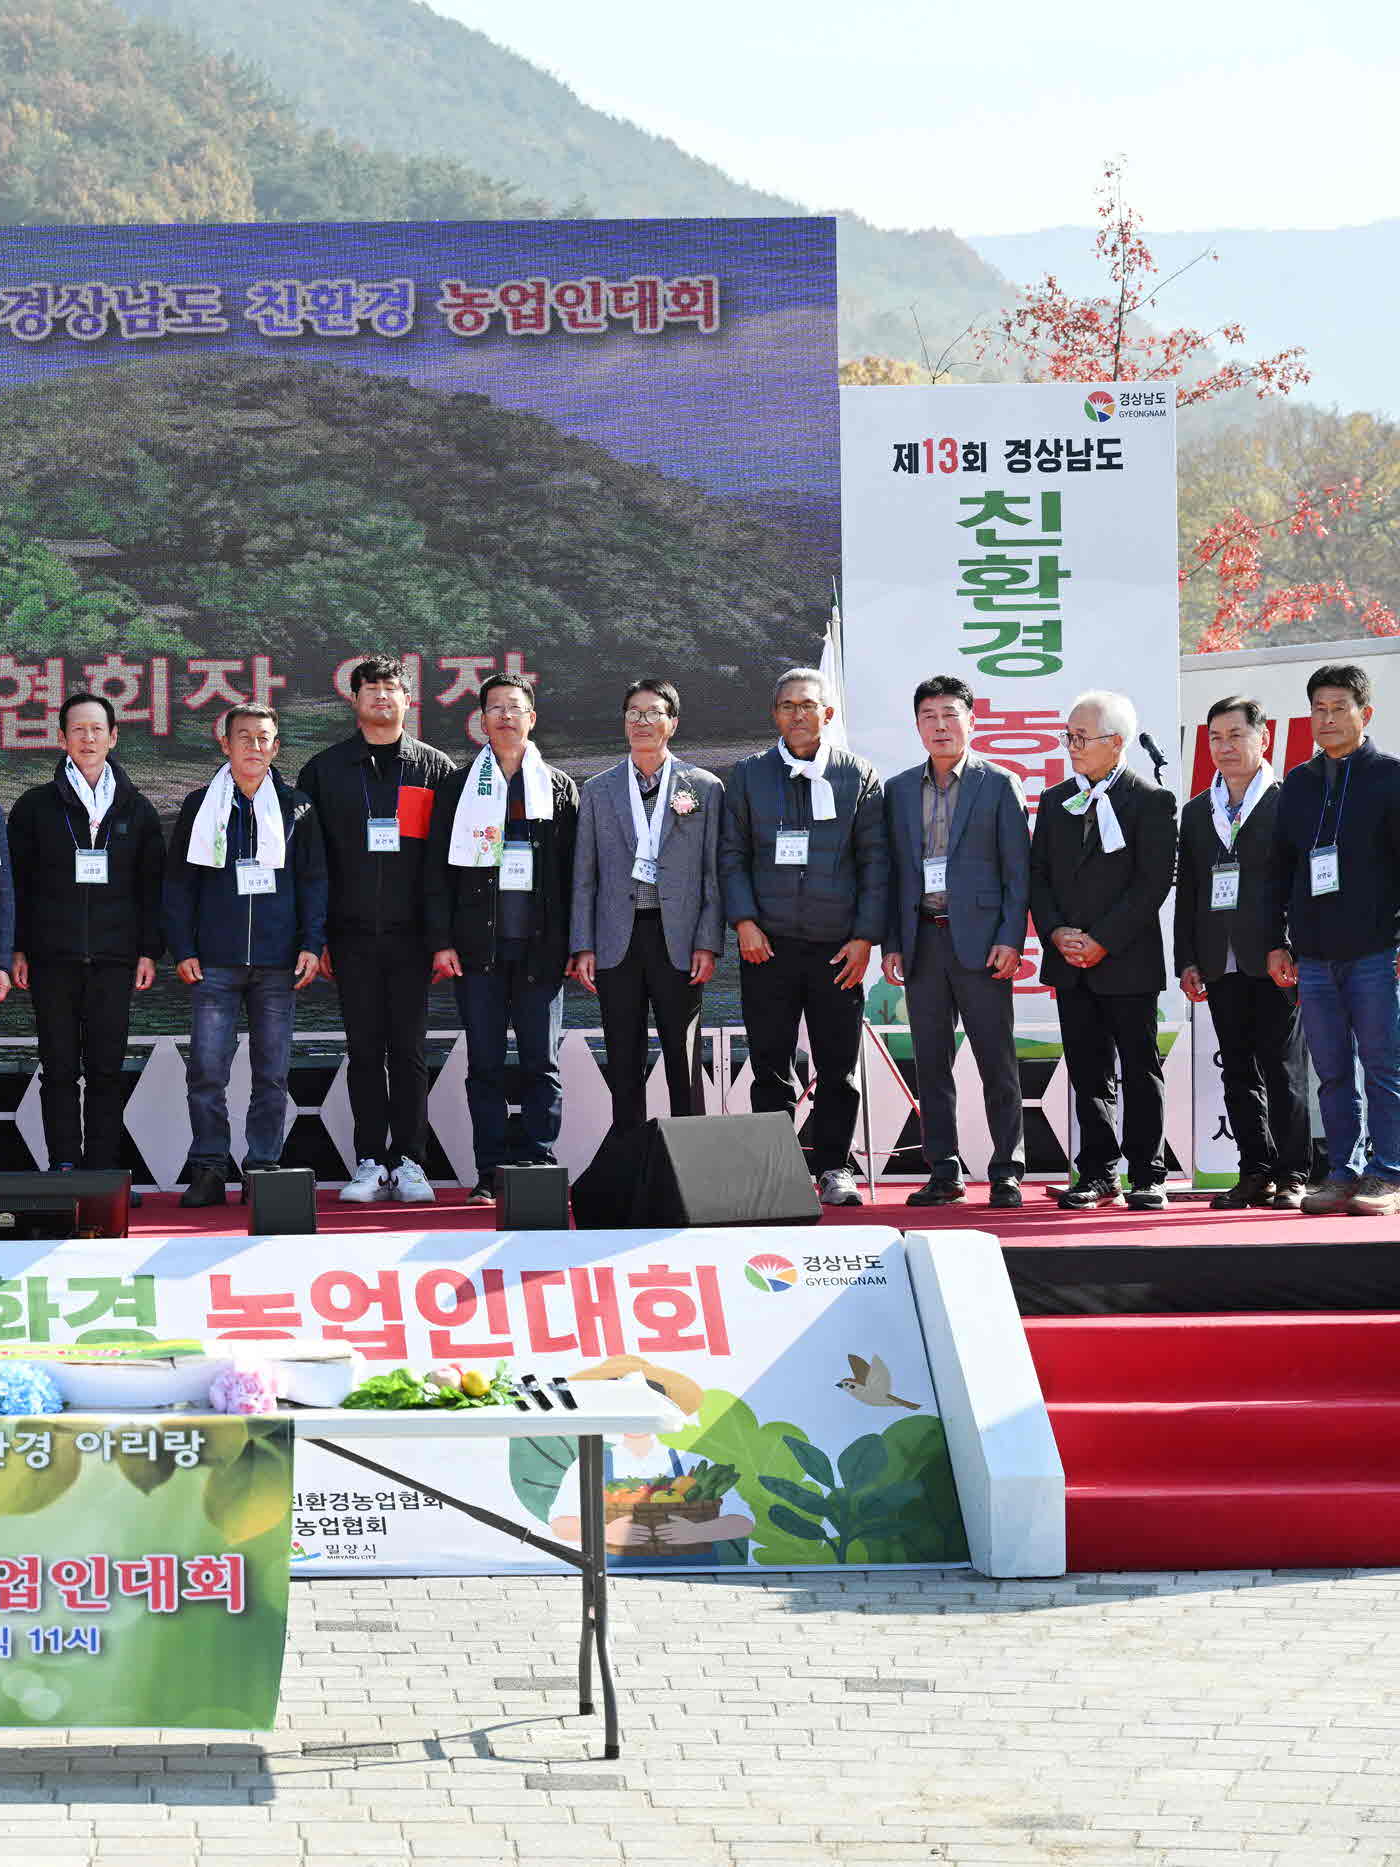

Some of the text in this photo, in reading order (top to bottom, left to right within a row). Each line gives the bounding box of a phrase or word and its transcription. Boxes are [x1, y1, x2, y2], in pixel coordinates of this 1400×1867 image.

[245, 279, 415, 337] 친환경
[437, 276, 722, 334] 농업인대회
[1119, 392, 1167, 407] 경상남도
[1119, 410, 1167, 418] GYEONGNAM
[892, 437, 1124, 474] 제13회 경상남도
[956, 490, 1071, 678] 친환경
[803, 1253, 885, 1272] 경상남도
[805, 1276, 887, 1286] GYEONGNAM
[75, 1430, 206, 1467] 아리랑
[295, 1516, 387, 1537] 농업협회
[28, 1626, 102, 1655] 11시
